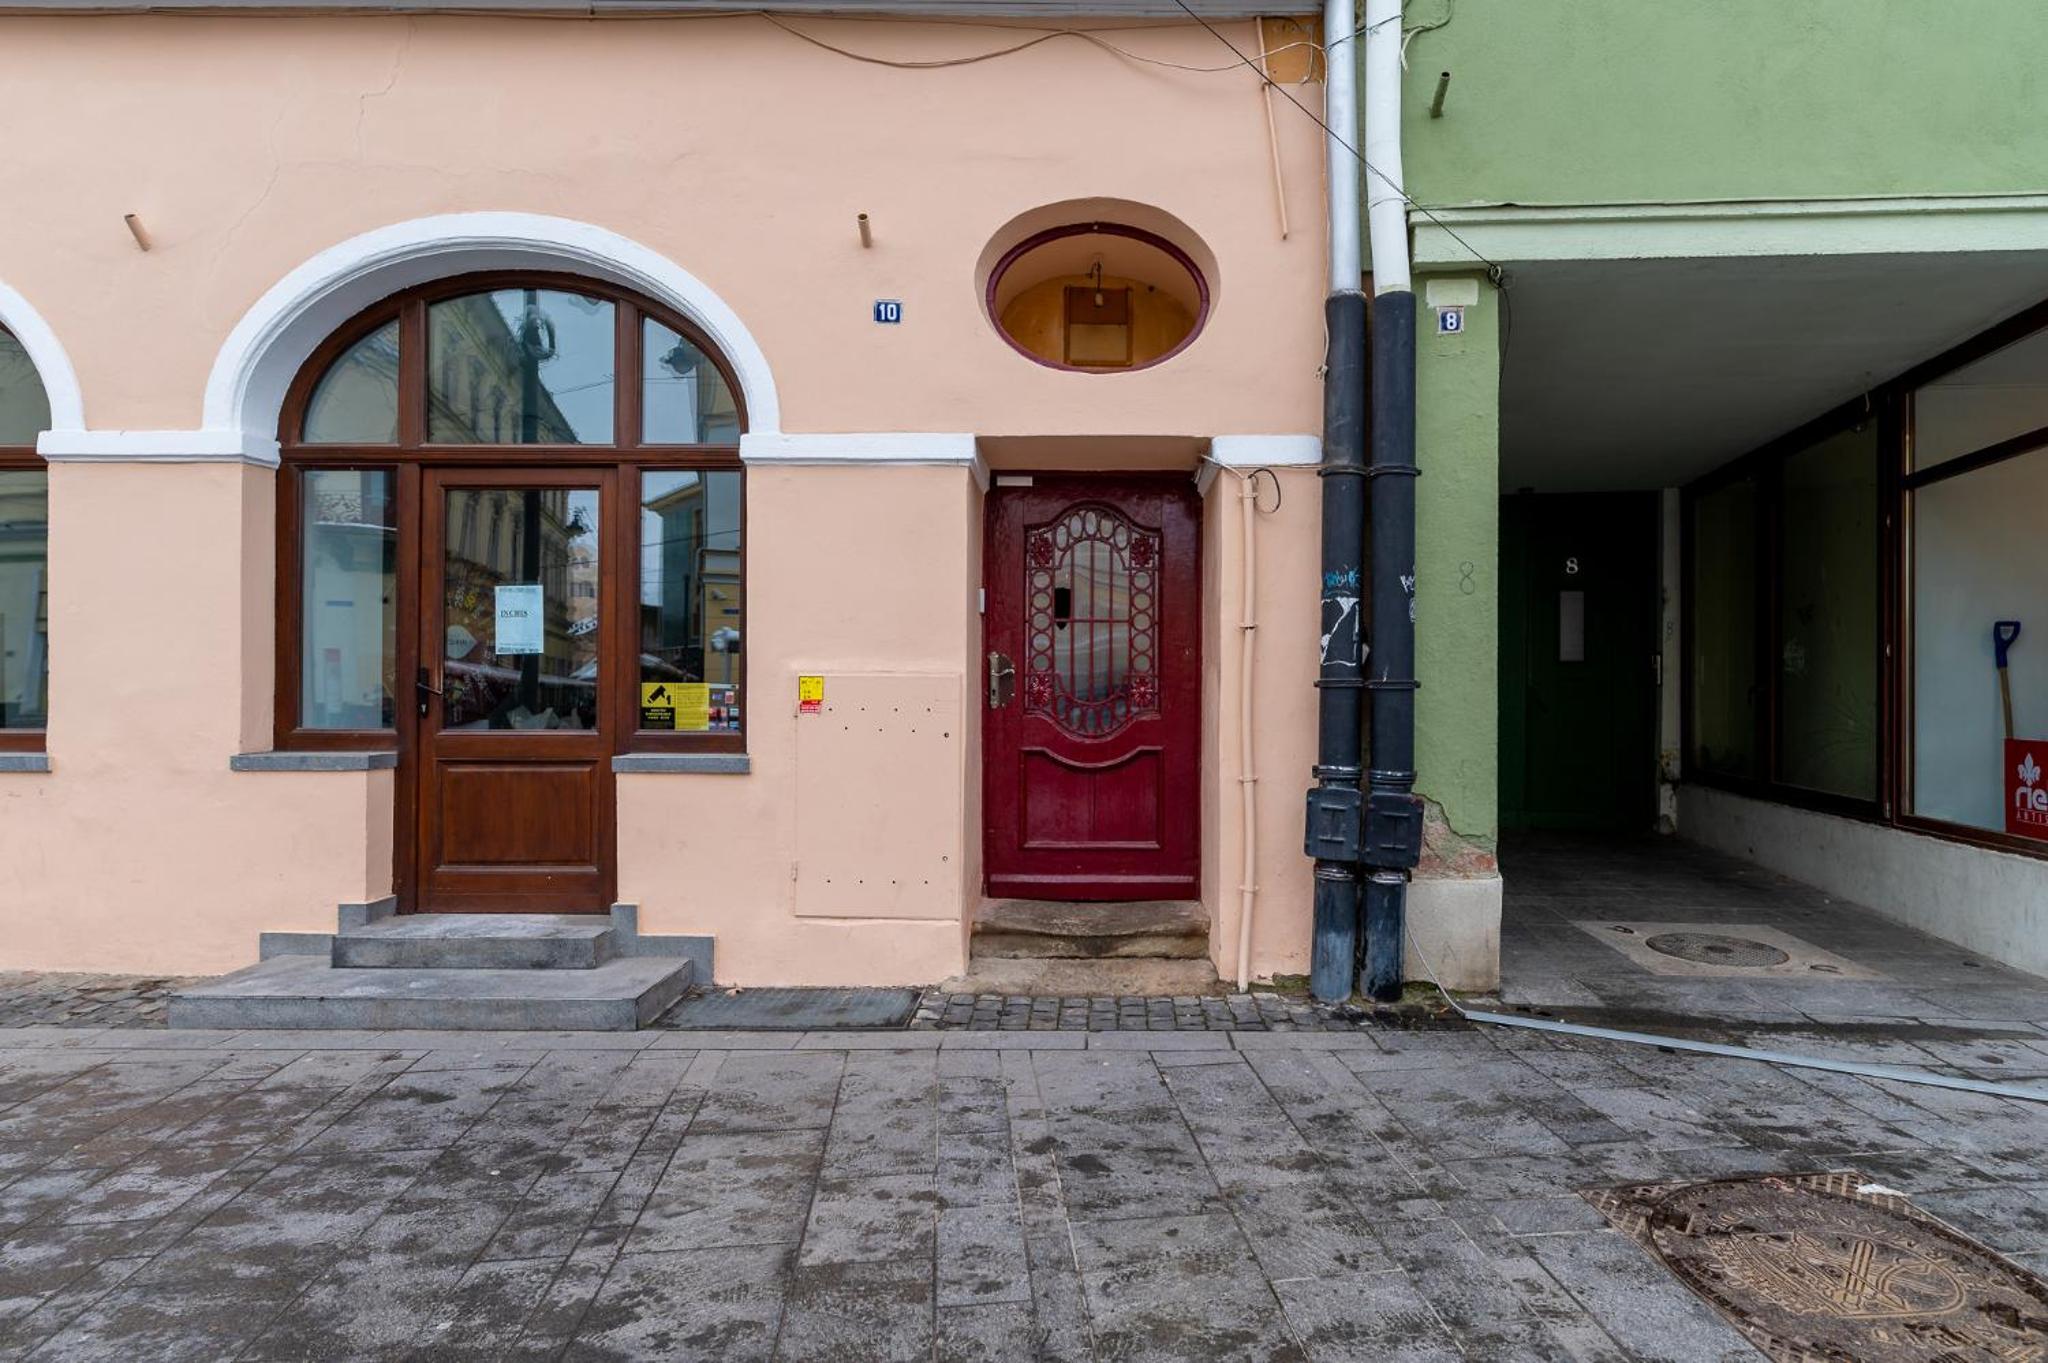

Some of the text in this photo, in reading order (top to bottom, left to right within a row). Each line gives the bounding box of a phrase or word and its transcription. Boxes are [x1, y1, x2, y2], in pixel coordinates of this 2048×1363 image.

[879, 304, 897, 320] 10
[1446, 312, 1457, 330] 8
[1566, 557, 1578, 575] 8
[1460, 561, 1475, 595] 8
